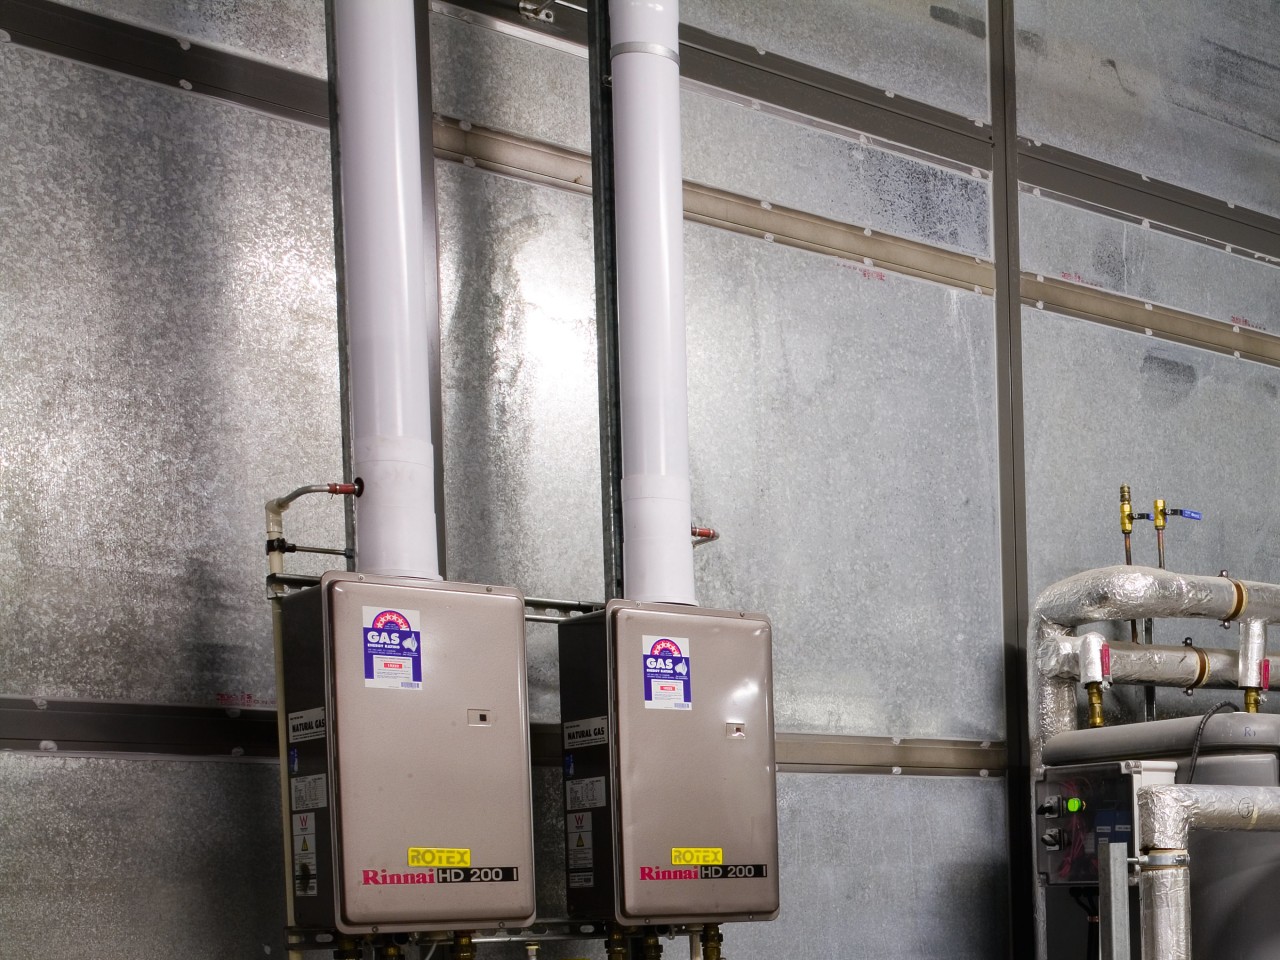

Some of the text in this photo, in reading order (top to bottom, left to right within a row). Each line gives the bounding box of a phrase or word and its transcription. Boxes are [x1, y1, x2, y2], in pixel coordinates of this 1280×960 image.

[367, 631, 400, 644] GAS
[646, 657, 674, 669] GAS
[292, 719, 325, 732] NATURAL GAS
[567, 727, 605, 740] NATURAL GAS
[410, 849, 469, 865] ROTEX
[673, 849, 721, 863] ROTEX
[362, 868, 436, 885] Rinnai
[438, 869, 464, 882] HD
[470, 868, 503, 882] 200
[639, 865, 698, 880] Rinnai
[701, 866, 723, 878] HD
[728, 865, 755, 877] 200
